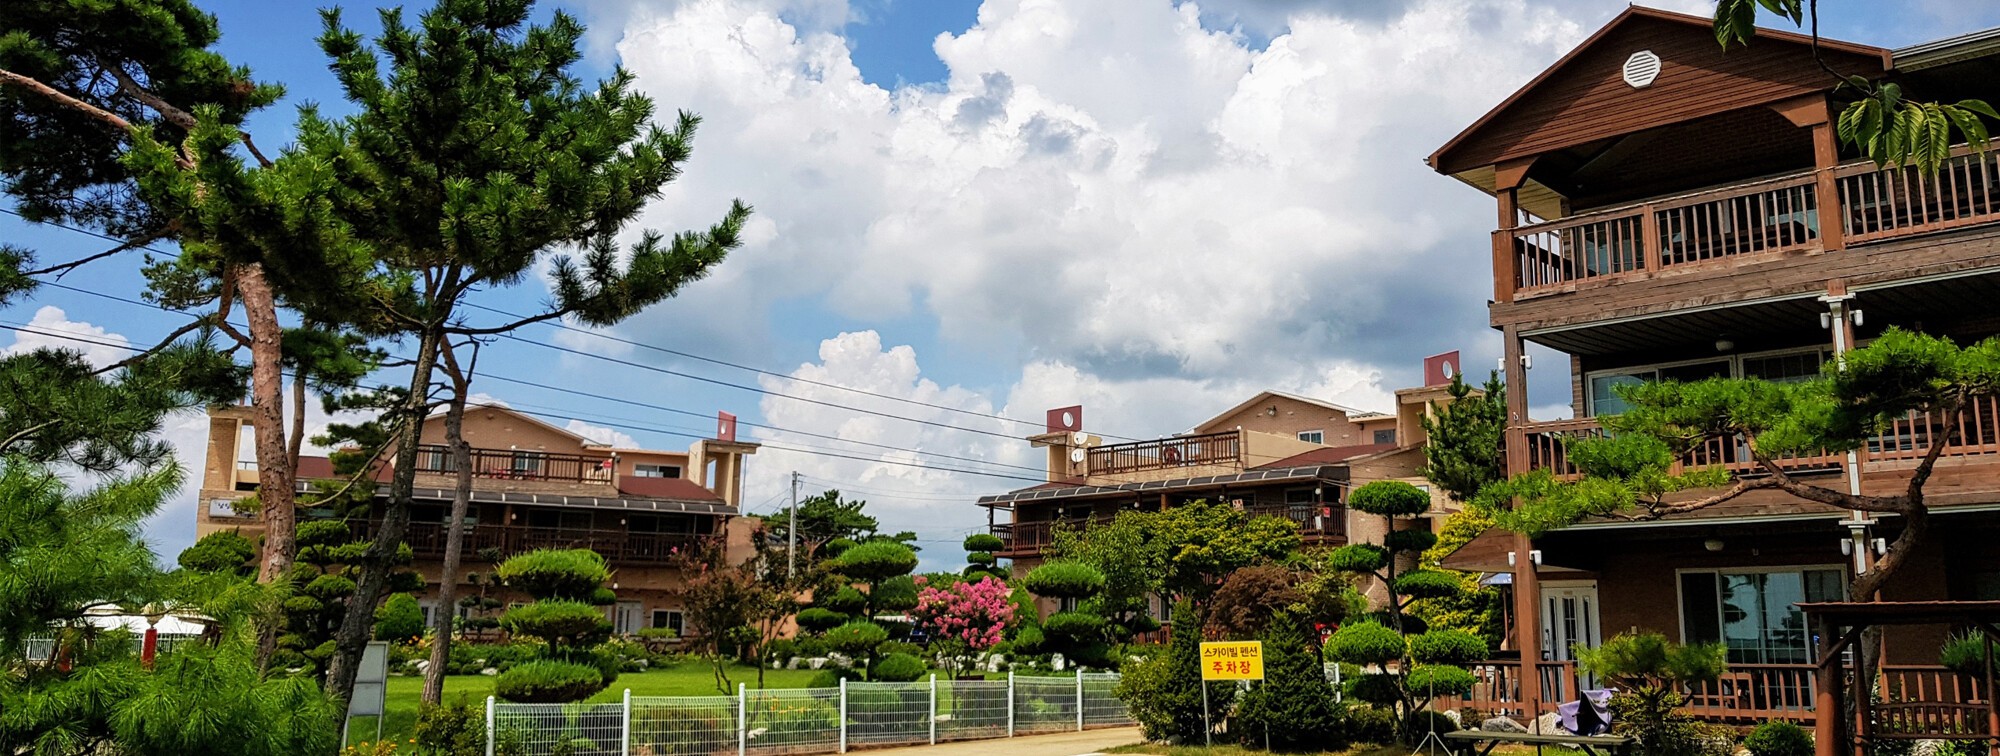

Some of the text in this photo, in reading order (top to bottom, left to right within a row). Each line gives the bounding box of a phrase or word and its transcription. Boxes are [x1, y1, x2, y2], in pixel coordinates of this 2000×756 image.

[1204, 646, 1258, 658] 스카이빌 펜션
[1212, 660, 1251, 675] 주차장
